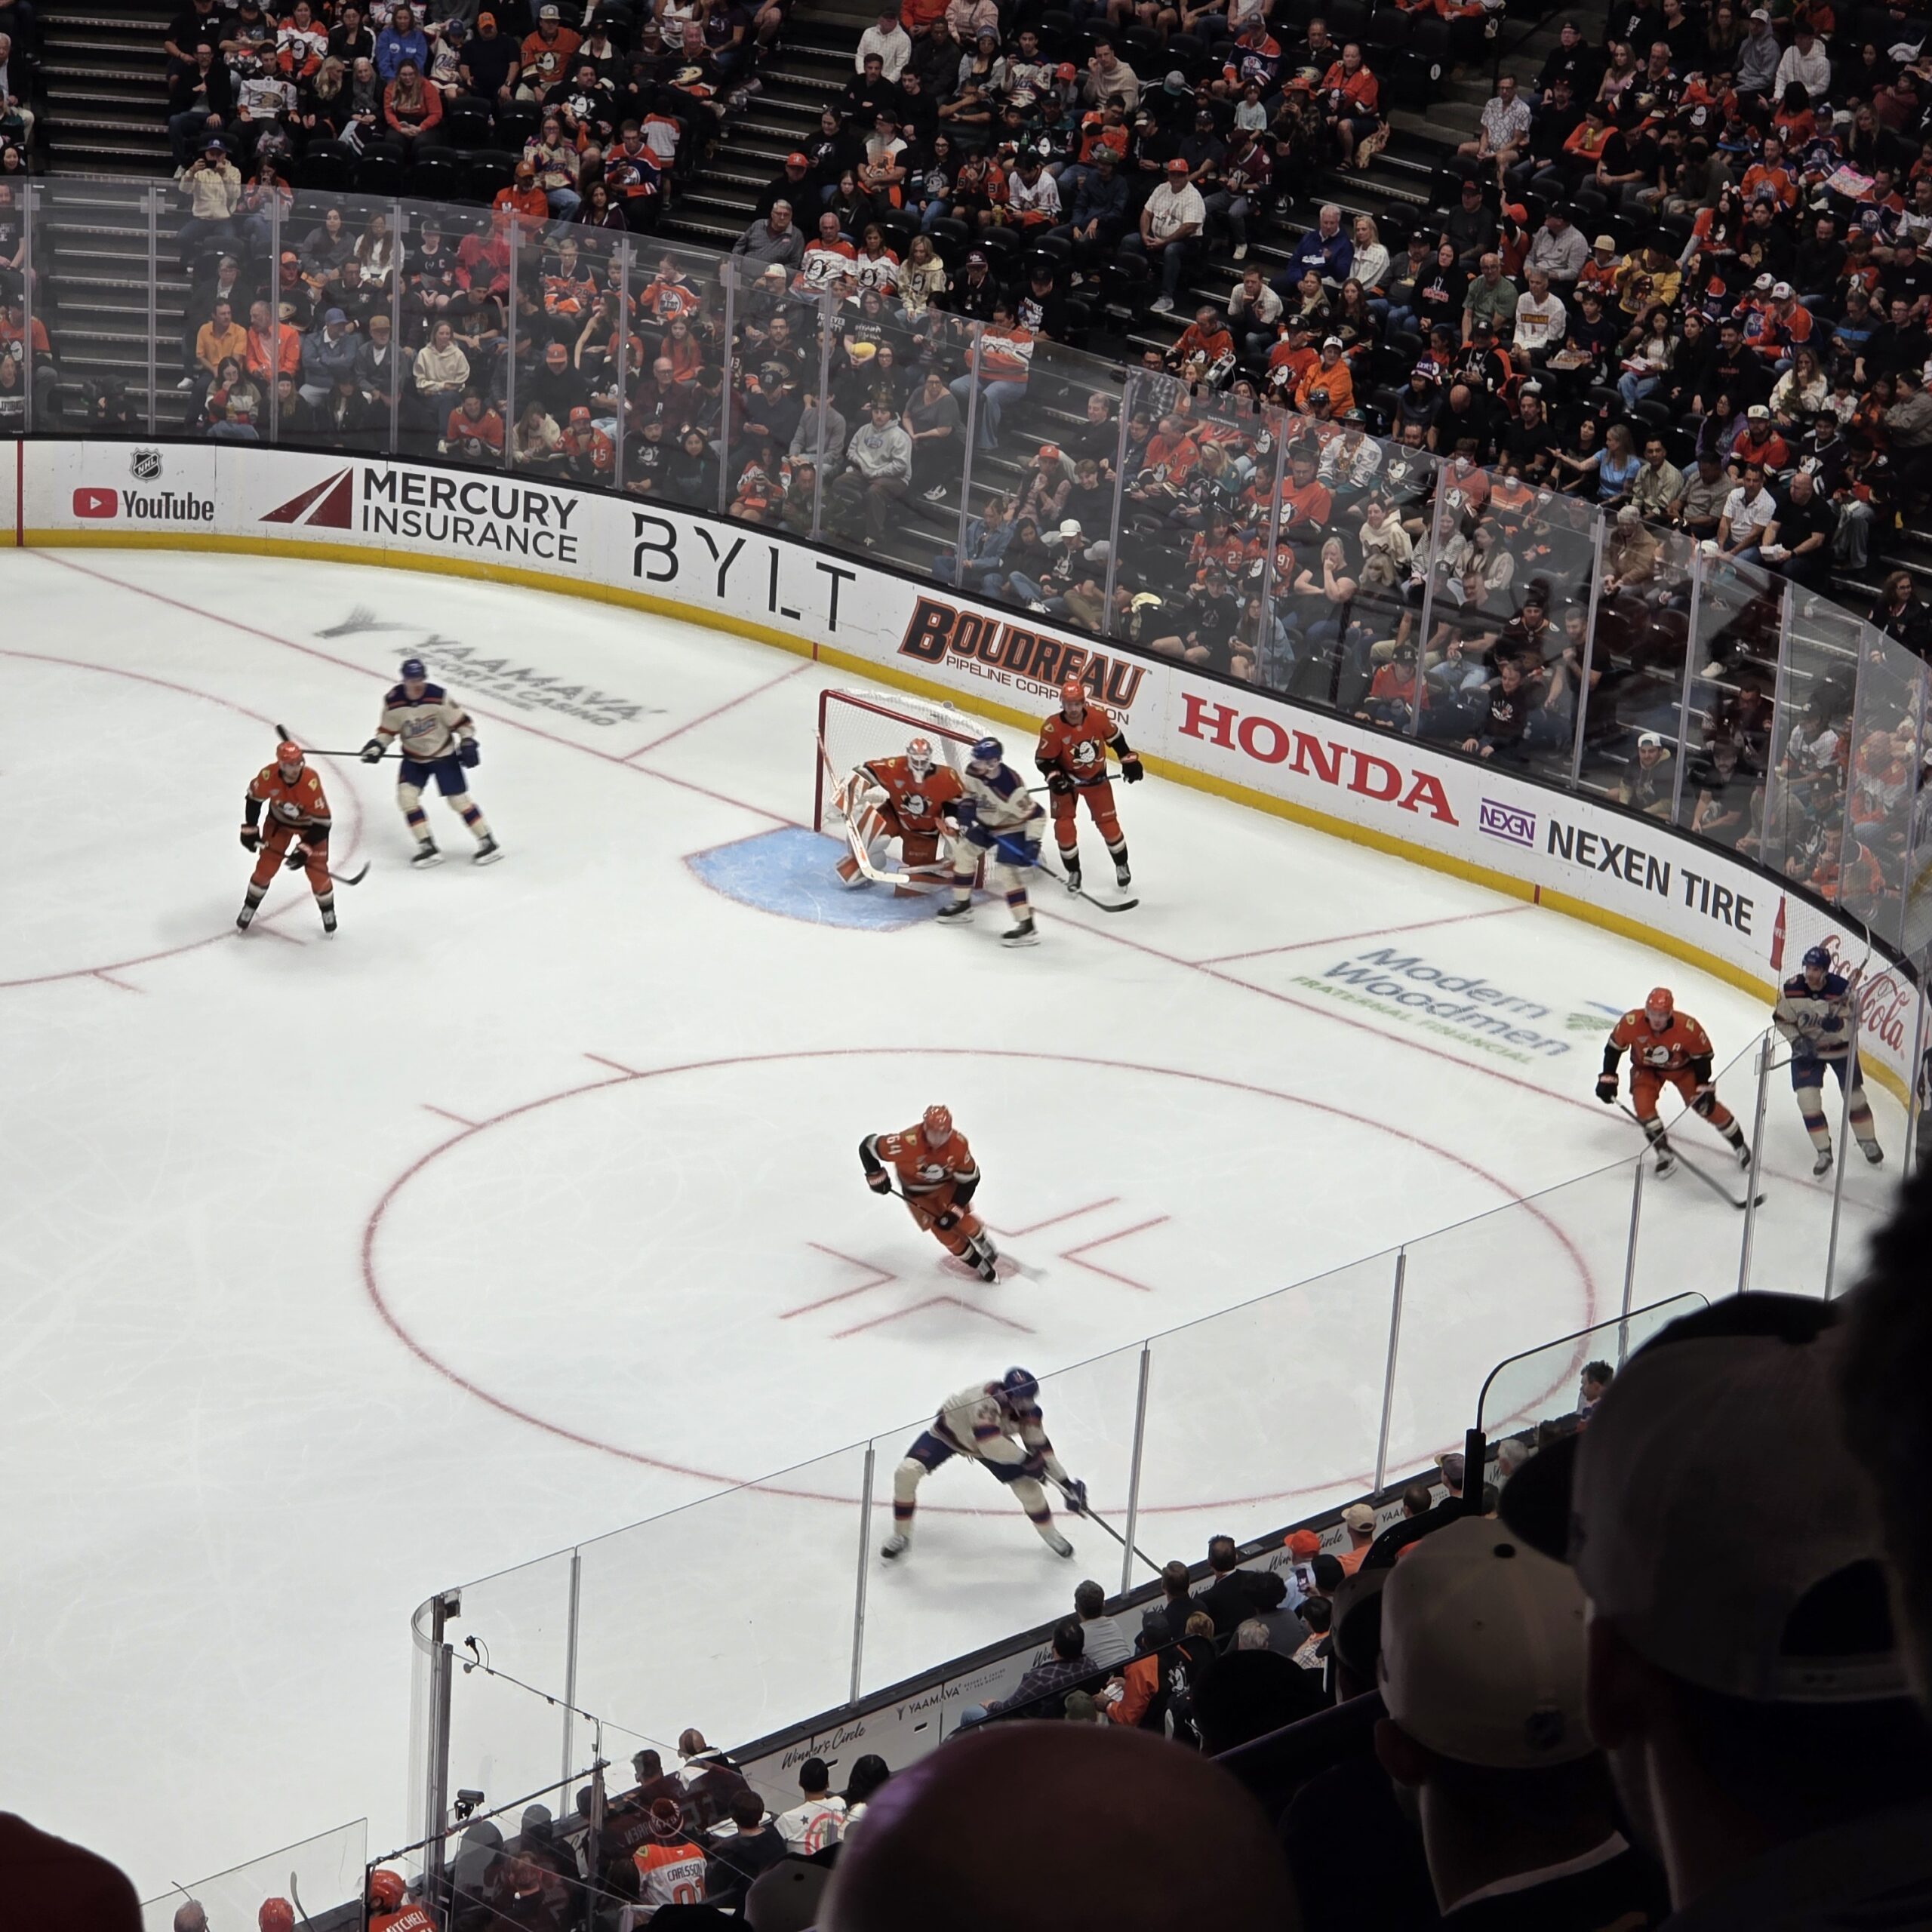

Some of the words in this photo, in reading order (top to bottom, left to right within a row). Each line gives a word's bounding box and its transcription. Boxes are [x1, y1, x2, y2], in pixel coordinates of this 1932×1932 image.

[817, 312, 845, 326] FOEVER
[137, 458, 157, 475] NHL
[1211, 485, 1220, 497] A
[122, 490, 214, 521] YouTube
[363, 467, 579, 530] MERCURY
[362, 505, 578, 564] INSURANCE
[1277, 554, 1290, 569] 91
[632, 511, 857, 632] BYLT
[897, 595, 1146, 709] BOUDREAU
[517, 691, 617, 727] CASINO
[946, 654, 1012, 687] PIPELINE
[1015, 678, 1130, 725] CORPON
[1178, 691, 1460, 828] HONDA
[1480, 804, 1536, 841] NEXEN
[1547, 819, 1671, 897] NEXEN
[1681, 868, 1754, 937] TIRE
[1323, 961, 1571, 1057] Woodmen
[1356, 947, 1550, 1020] Modern
[1291, 976, 1412, 1021] FRATERNAL
[1417, 1020, 1534, 1064] FINANCIAL
[781, 1737, 831, 1770] Winner's
[832, 1721, 866, 1751] Circle
[667, 1862, 703, 1881] CARLSSON
